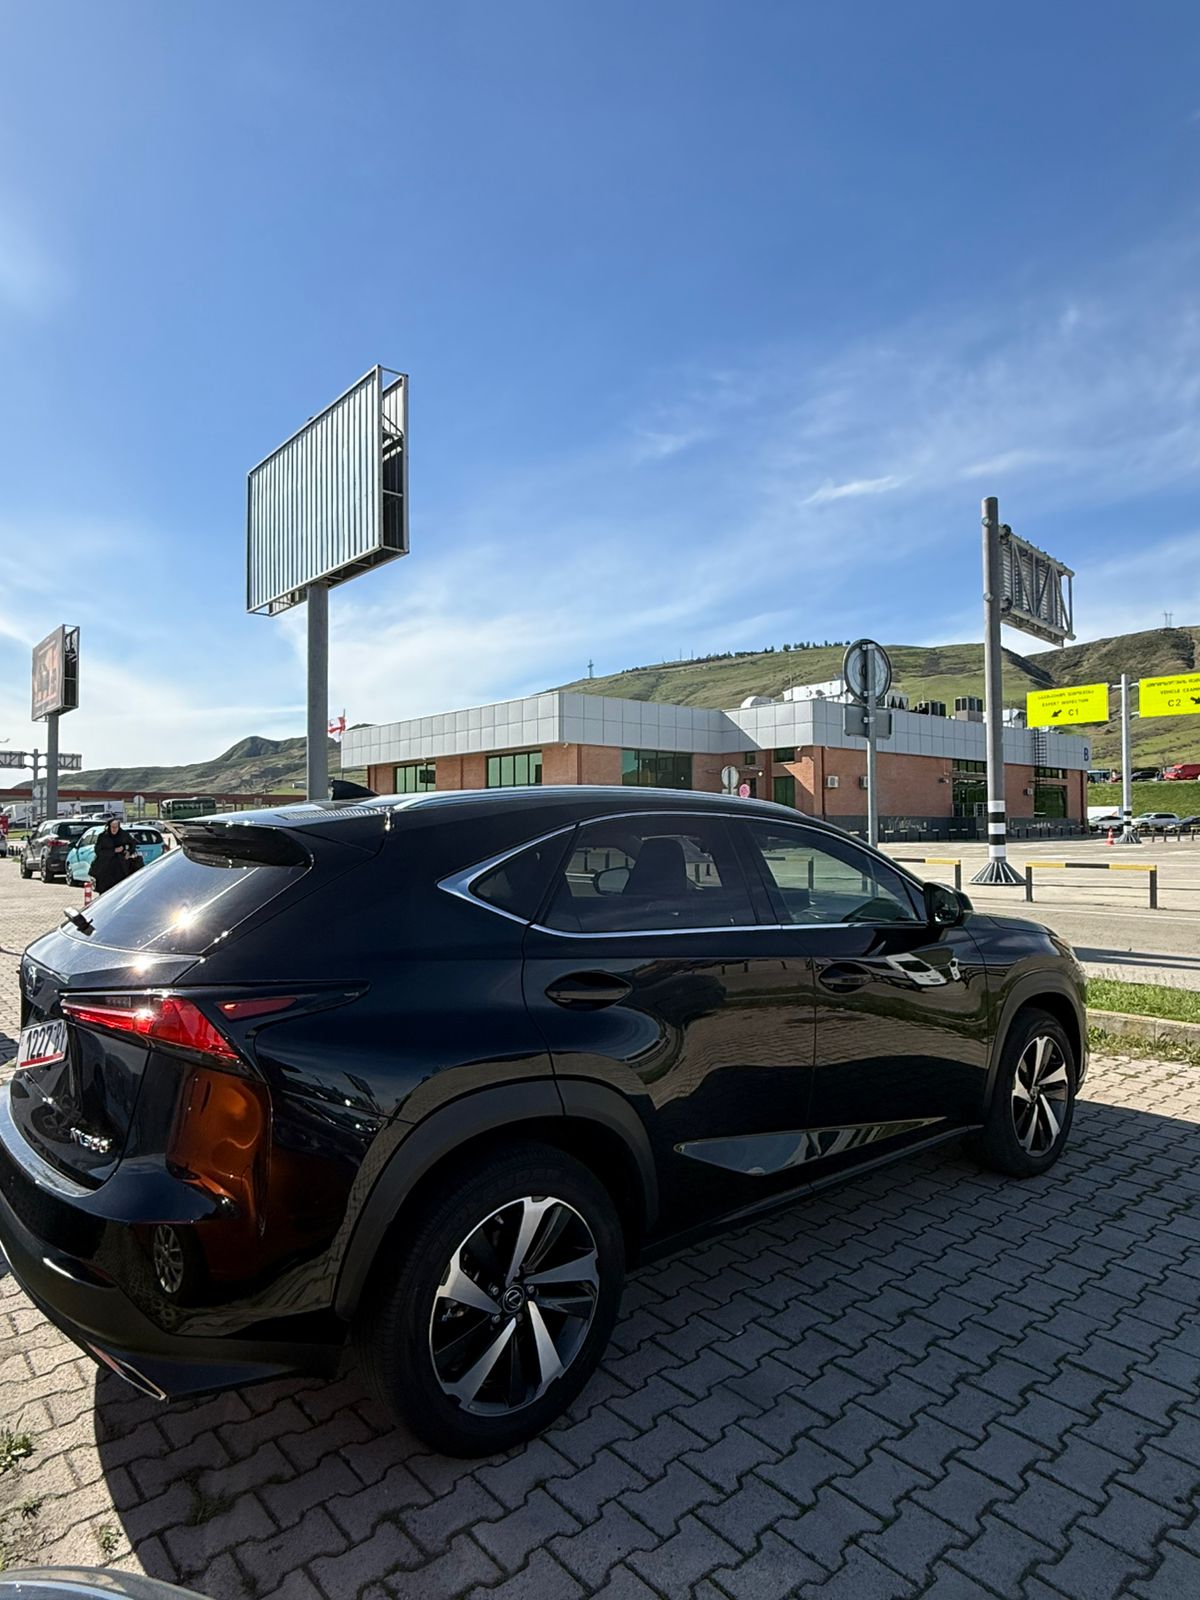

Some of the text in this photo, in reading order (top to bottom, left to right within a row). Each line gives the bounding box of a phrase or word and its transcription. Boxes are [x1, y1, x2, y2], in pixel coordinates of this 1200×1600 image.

[1168, 698, 1181, 707] C2
[1068, 708, 1078, 716] C1
[1083, 747, 1089, 761] B
